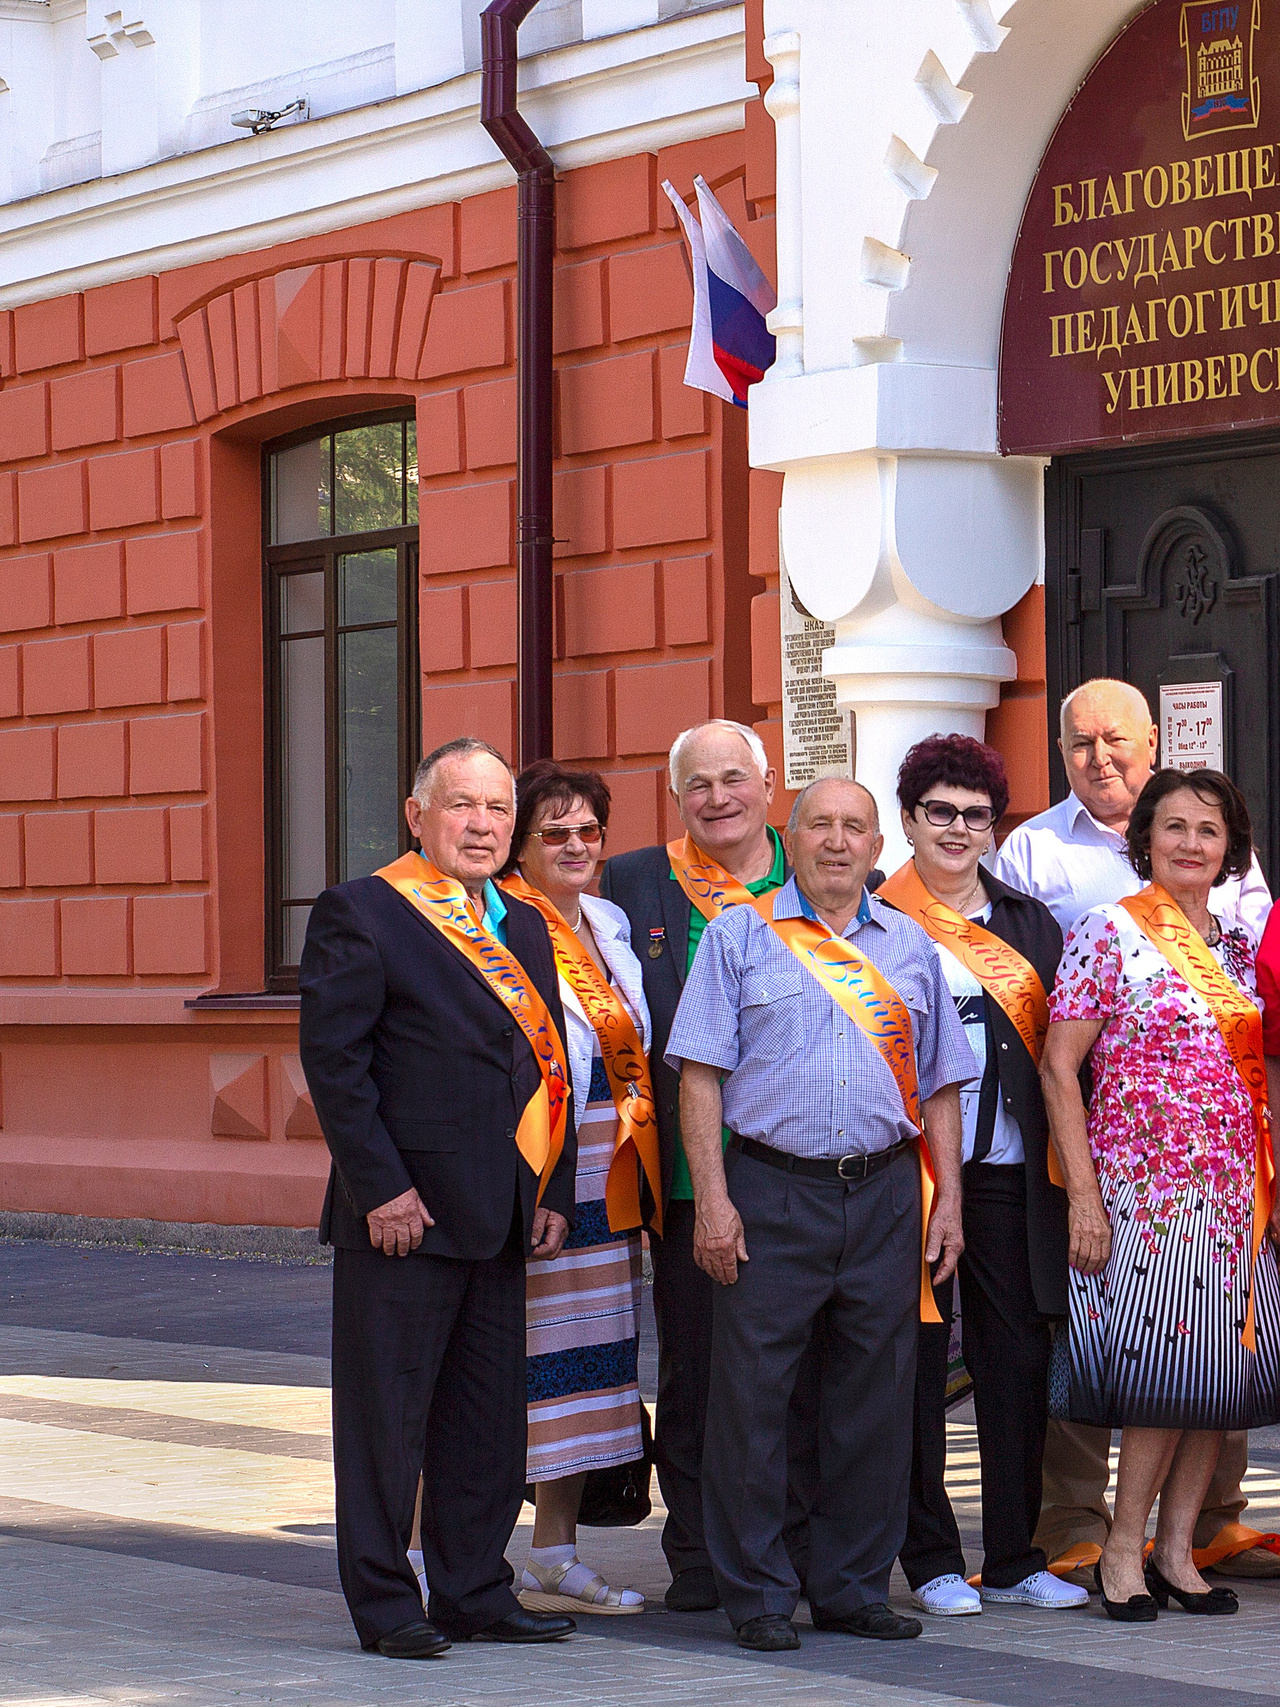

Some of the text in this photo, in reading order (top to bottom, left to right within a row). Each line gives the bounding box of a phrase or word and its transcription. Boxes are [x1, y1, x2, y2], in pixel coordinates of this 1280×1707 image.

[1201, 4, 1239, 33] БГПУ
[804, 620, 824, 631] УКАЗ
[1172, 701, 1208, 710] ЧАСЫ РАБОТЫ
[412, 879, 532, 1007] Выпуск
[919, 901, 1035, 1013] Выпуск
[992, 944, 1010, 958] 50
[573, 955, 594, 973] 50
[1142, 903, 1249, 1035] Выпуск
[1205, 961, 1224, 981] 50
[807, 937, 910, 1075] Выпуск
[989, 982, 1035, 1045] ФВиС БГПИ
[1206, 997, 1230, 1028] ФВиС
